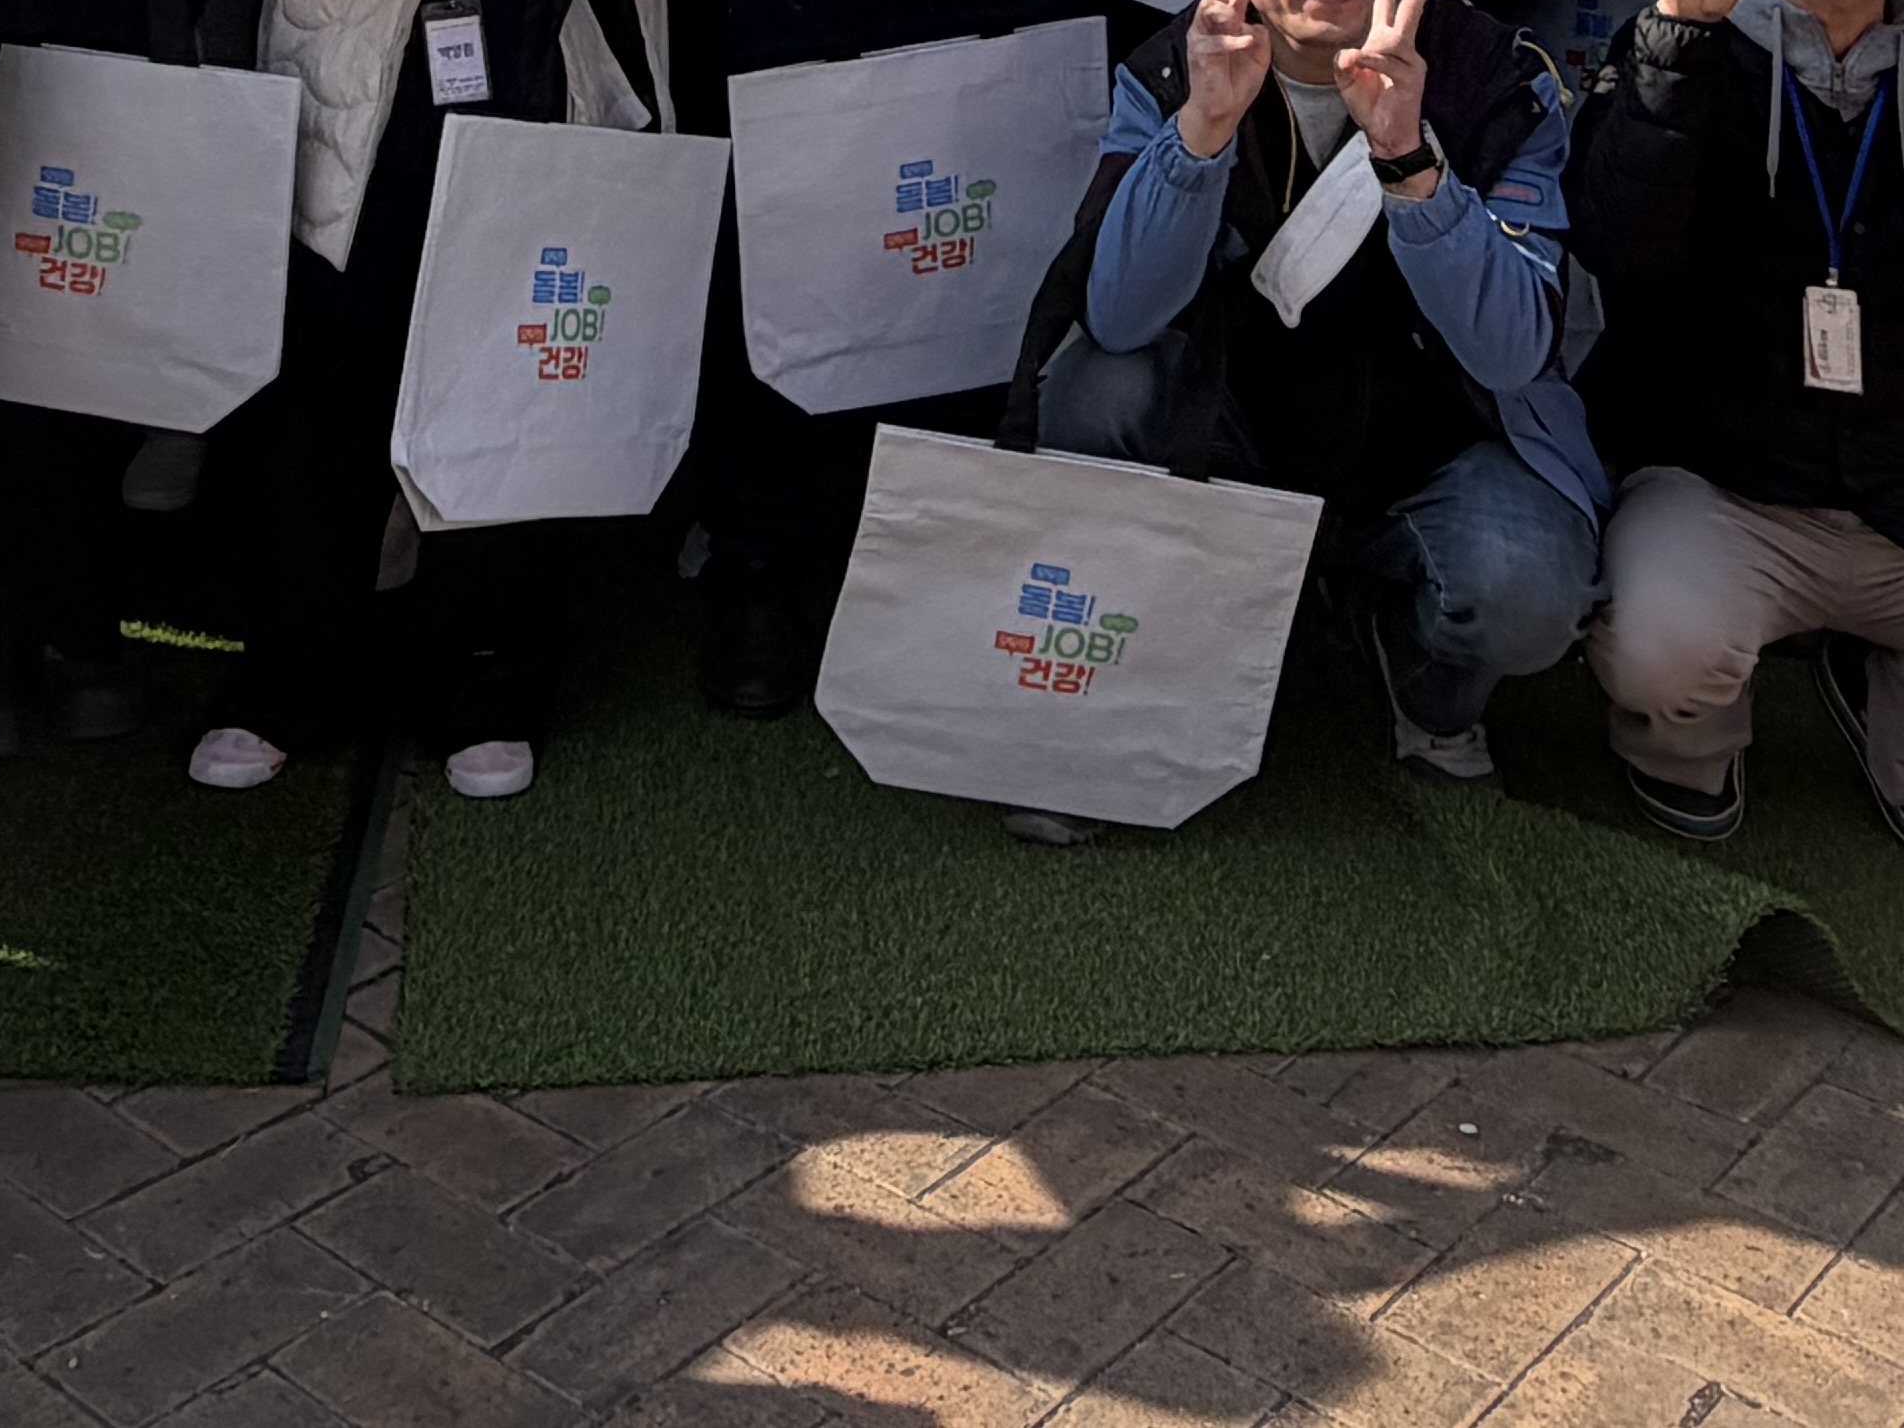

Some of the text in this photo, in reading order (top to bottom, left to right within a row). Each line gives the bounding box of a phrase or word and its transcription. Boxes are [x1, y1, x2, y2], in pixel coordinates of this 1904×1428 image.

[922, 200, 992, 241] JOB!
[52, 224, 132, 264] JOB!
[911, 236, 975, 275] 건강!
[39, 255, 107, 296] 건강!
[550, 307, 606, 343] JOB!
[538, 345, 589, 380] 건강!
[1037, 623, 1126, 665] JOB!
[1017, 656, 1096, 696] 건강!
